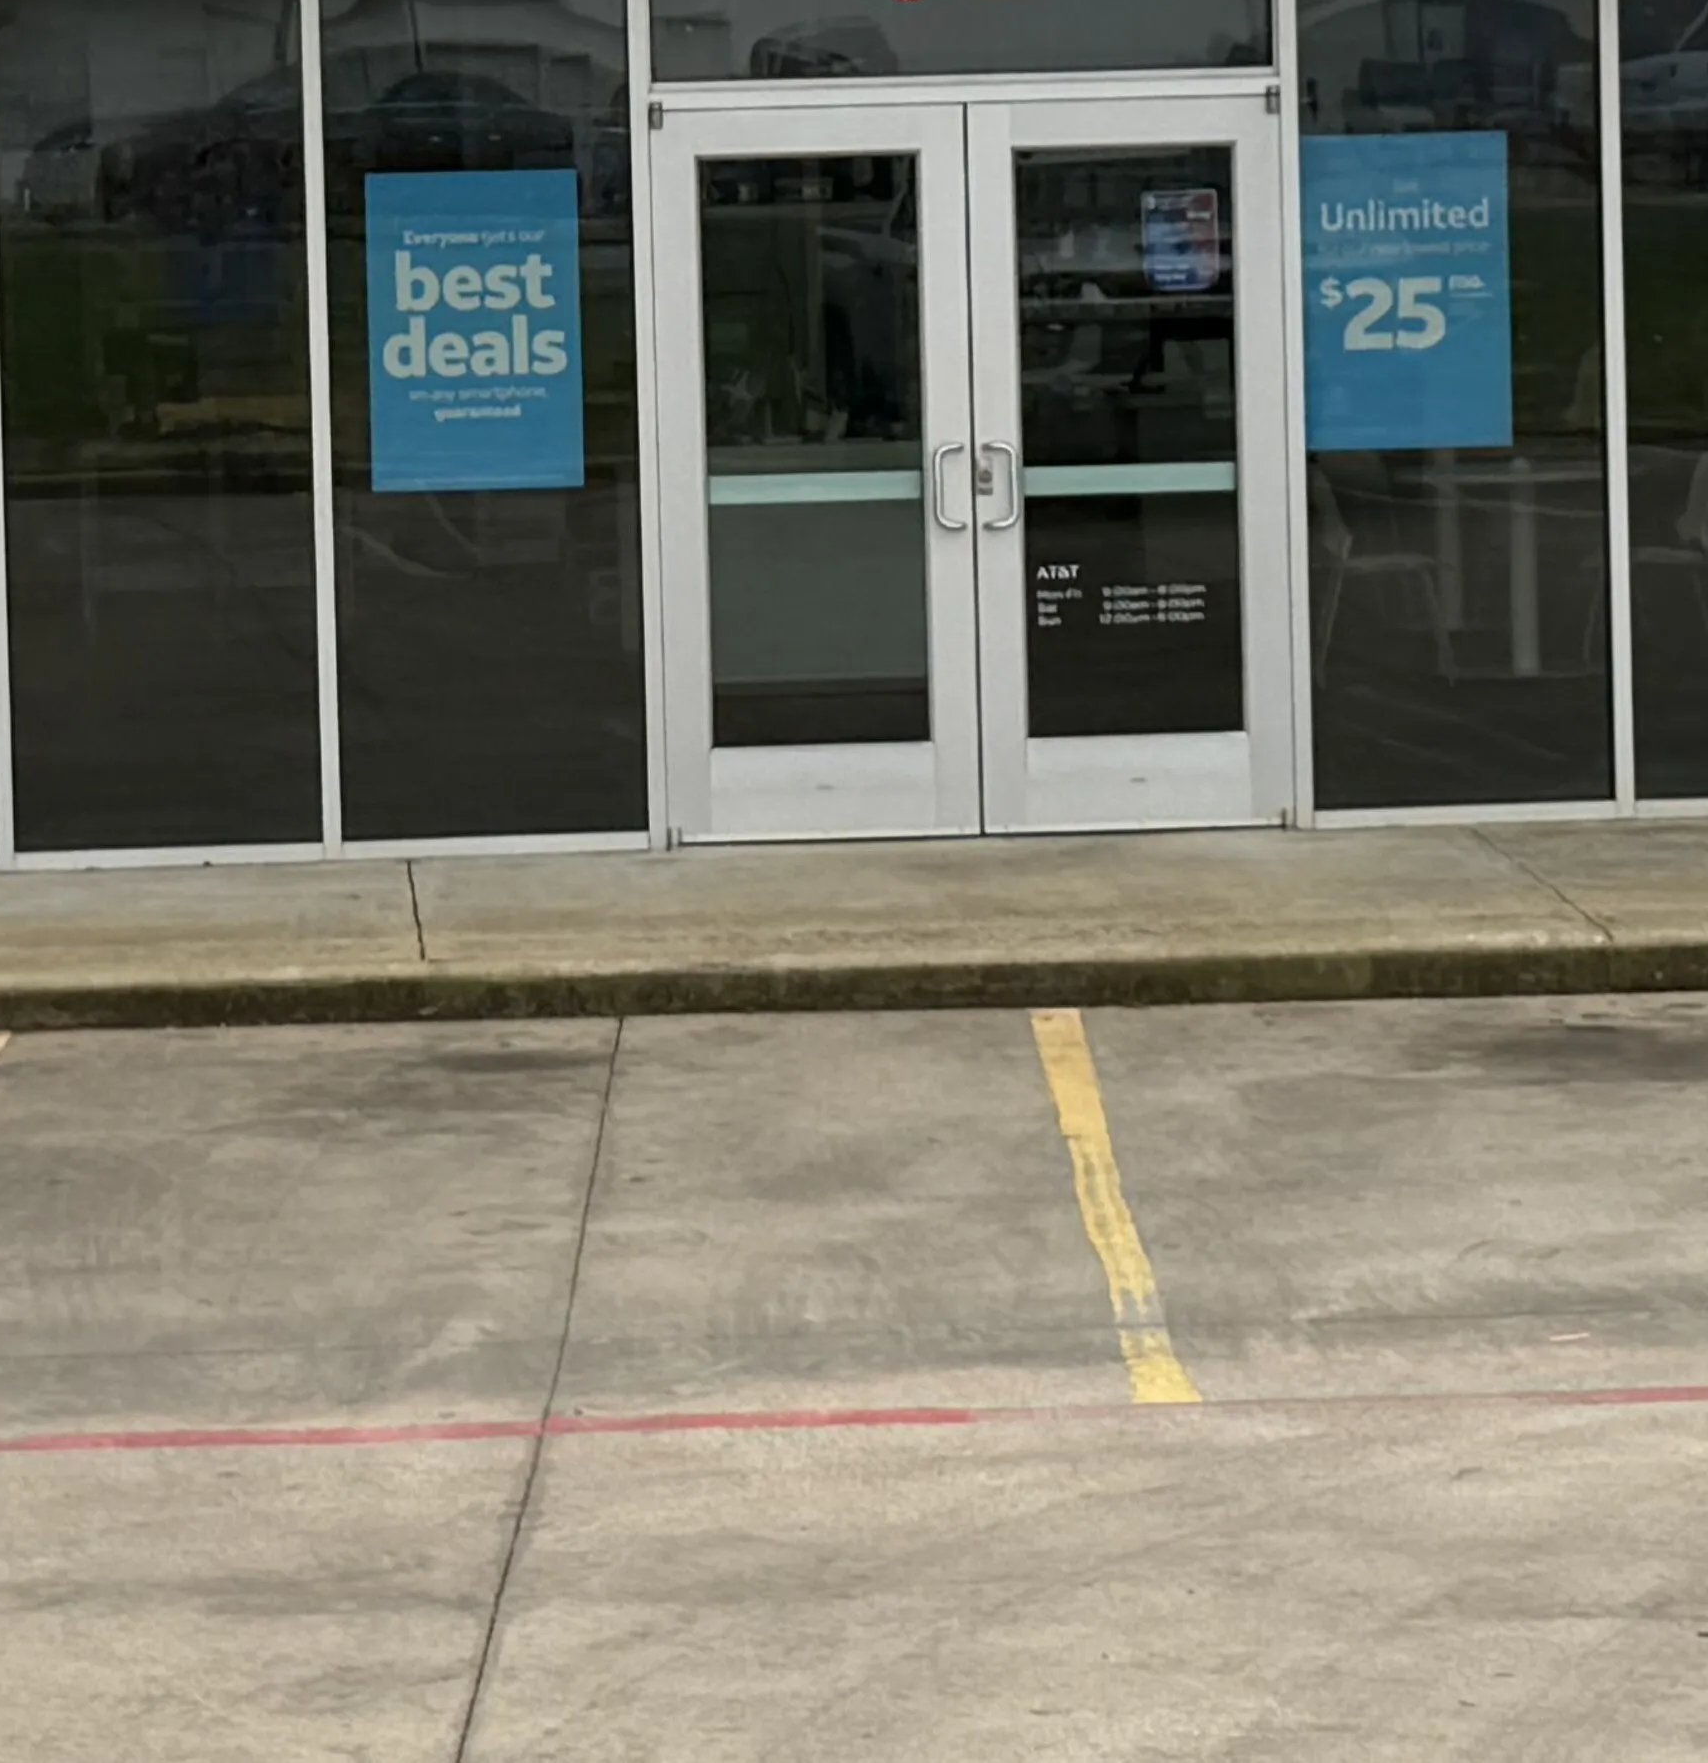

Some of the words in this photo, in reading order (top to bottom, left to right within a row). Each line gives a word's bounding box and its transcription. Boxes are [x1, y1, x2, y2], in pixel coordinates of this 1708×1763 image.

[1320, 197, 1490, 232] Unlimited
[395, 250, 556, 311] best
[1319, 275, 1447, 352] $25
[382, 314, 568, 379] deals
[1036, 564, 1081, 580] AT&T
